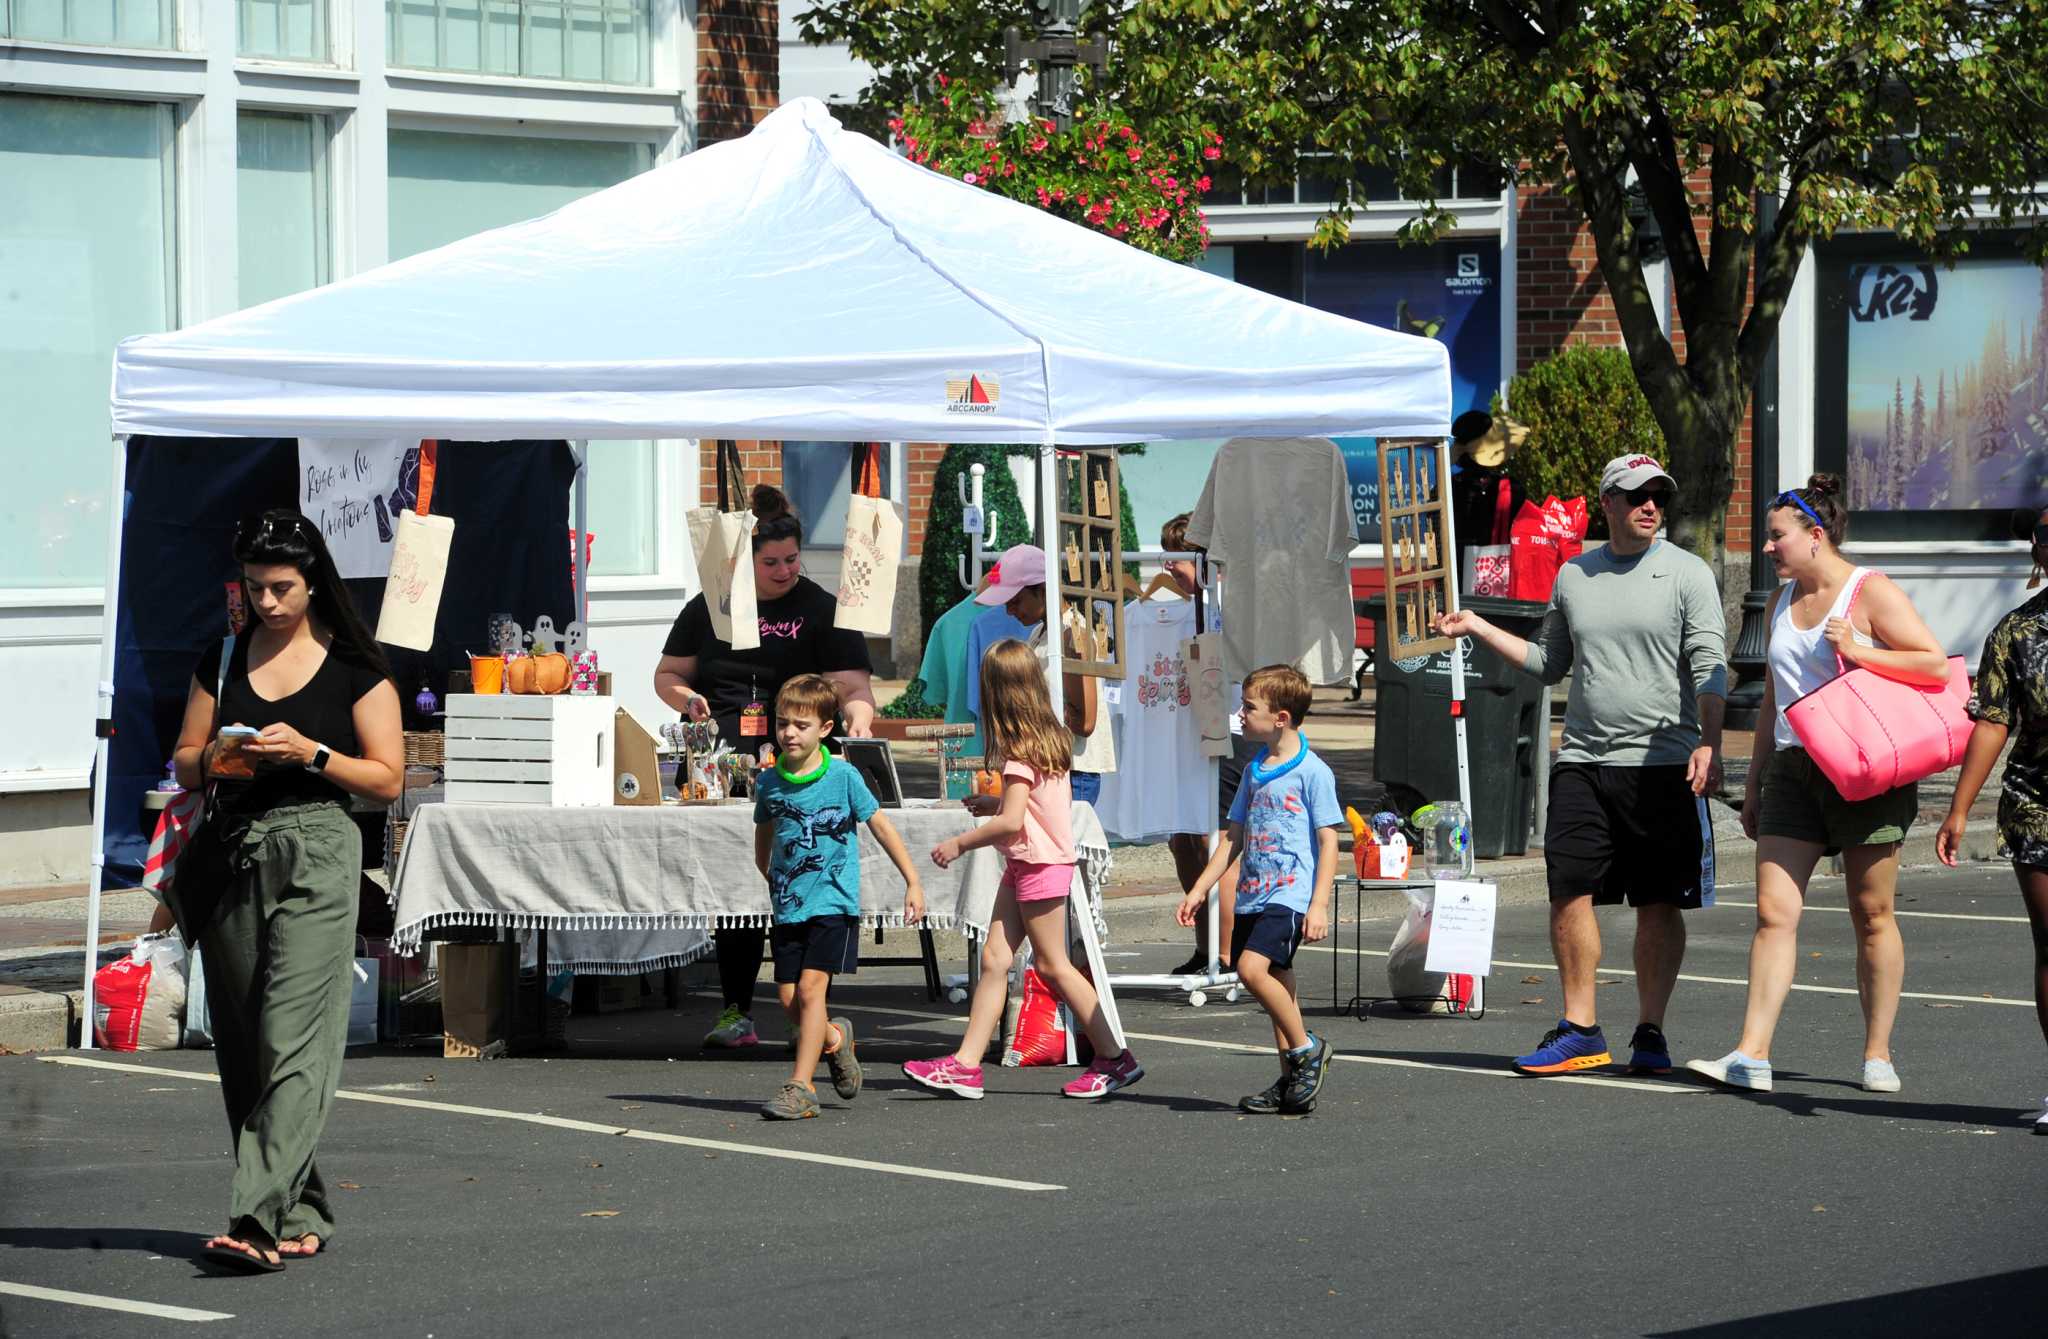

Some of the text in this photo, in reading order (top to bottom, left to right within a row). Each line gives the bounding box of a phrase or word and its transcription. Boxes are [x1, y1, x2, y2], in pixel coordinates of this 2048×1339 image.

[1445, 278, 1491, 287] salomon
[946, 404, 996, 413] ABCCANOPY
[1354, 499, 1375, 510] ON
[1436, 660, 1473, 671] RECLE
